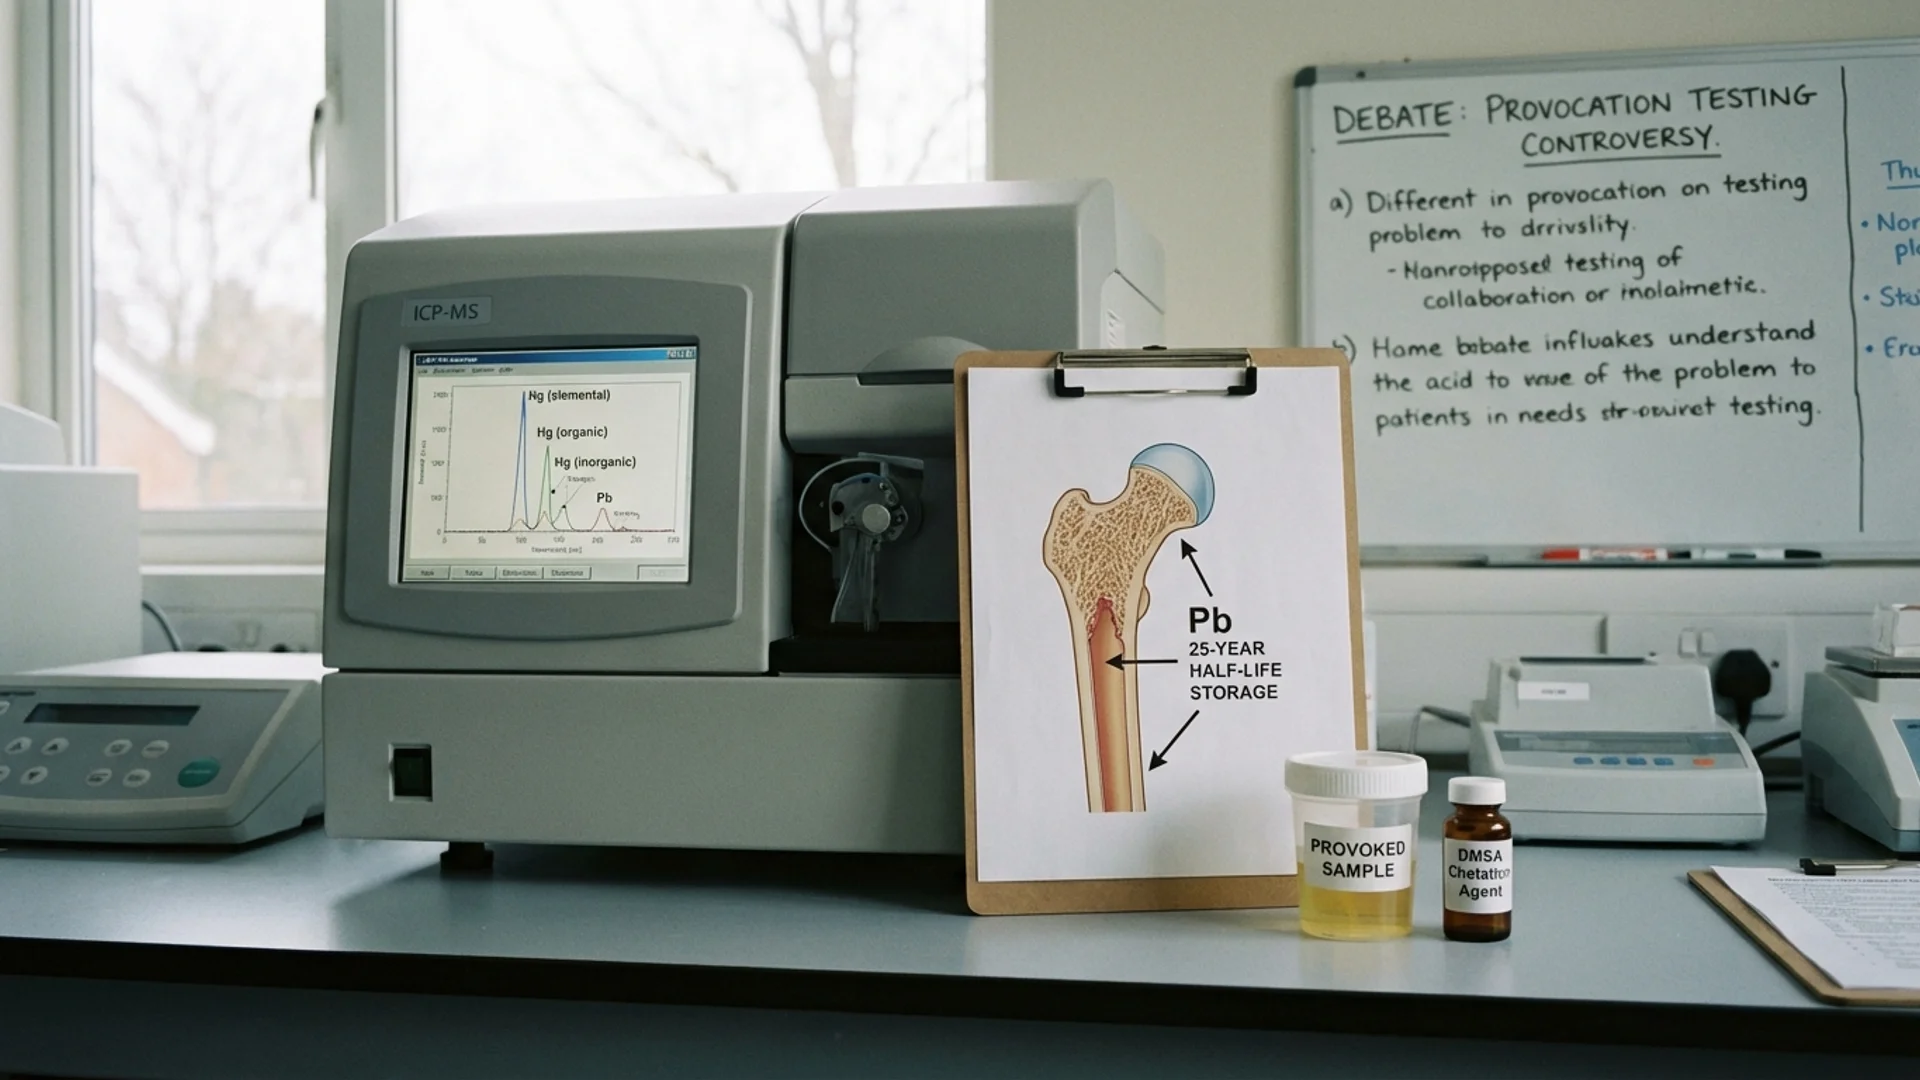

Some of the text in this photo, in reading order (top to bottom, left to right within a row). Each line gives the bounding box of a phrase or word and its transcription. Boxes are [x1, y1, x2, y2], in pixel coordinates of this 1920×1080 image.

[1333, 83, 1818, 134] DEBATE: PROVOCATION TESTING
[1329, 171, 1808, 219] a) Different in provocation on testing
[1369, 222, 1462, 253] problem
[1480, 219, 1507, 239] to
[1564, 251, 1645, 281] testing
[1656, 244, 1684, 268] of
[1423, 285, 1576, 310] collaboration
[1584, 287, 1610, 304] or
[413, 303, 479, 321] ICP-MS
[1668, 318, 1817, 346] understand
[1372, 373, 1413, 393] the
[1425, 369, 1473, 391] acid
[1485, 369, 1511, 389] to
[1583, 361, 1610, 386] of
[1622, 362, 1663, 383] the
[1674, 357, 1777, 390] problem
[1790, 356, 1817, 377] to
[1375, 406, 1472, 437] patients
[1487, 406, 1508, 424] in
[1518, 402, 1587, 424] needs
[1732, 394, 1821, 427] testing.
[537, 425, 608, 441] Hg (organic)
[554, 455, 637, 471] Hg (inorganic)
[596, 491, 613, 504] Pb
[1189, 606, 1233, 634] Pb
[1188, 640, 1266, 657] 25-YEAR
[1189, 662, 1283, 678] HALF-LIFE
[1190, 684, 1279, 701] STORAGE
[1310, 838, 1406, 858] PROVOKED
[1458, 848, 1503, 862] DMSA
[1322, 860, 1394, 878] SAMPLE
[1459, 884, 1503, 901] Agent
